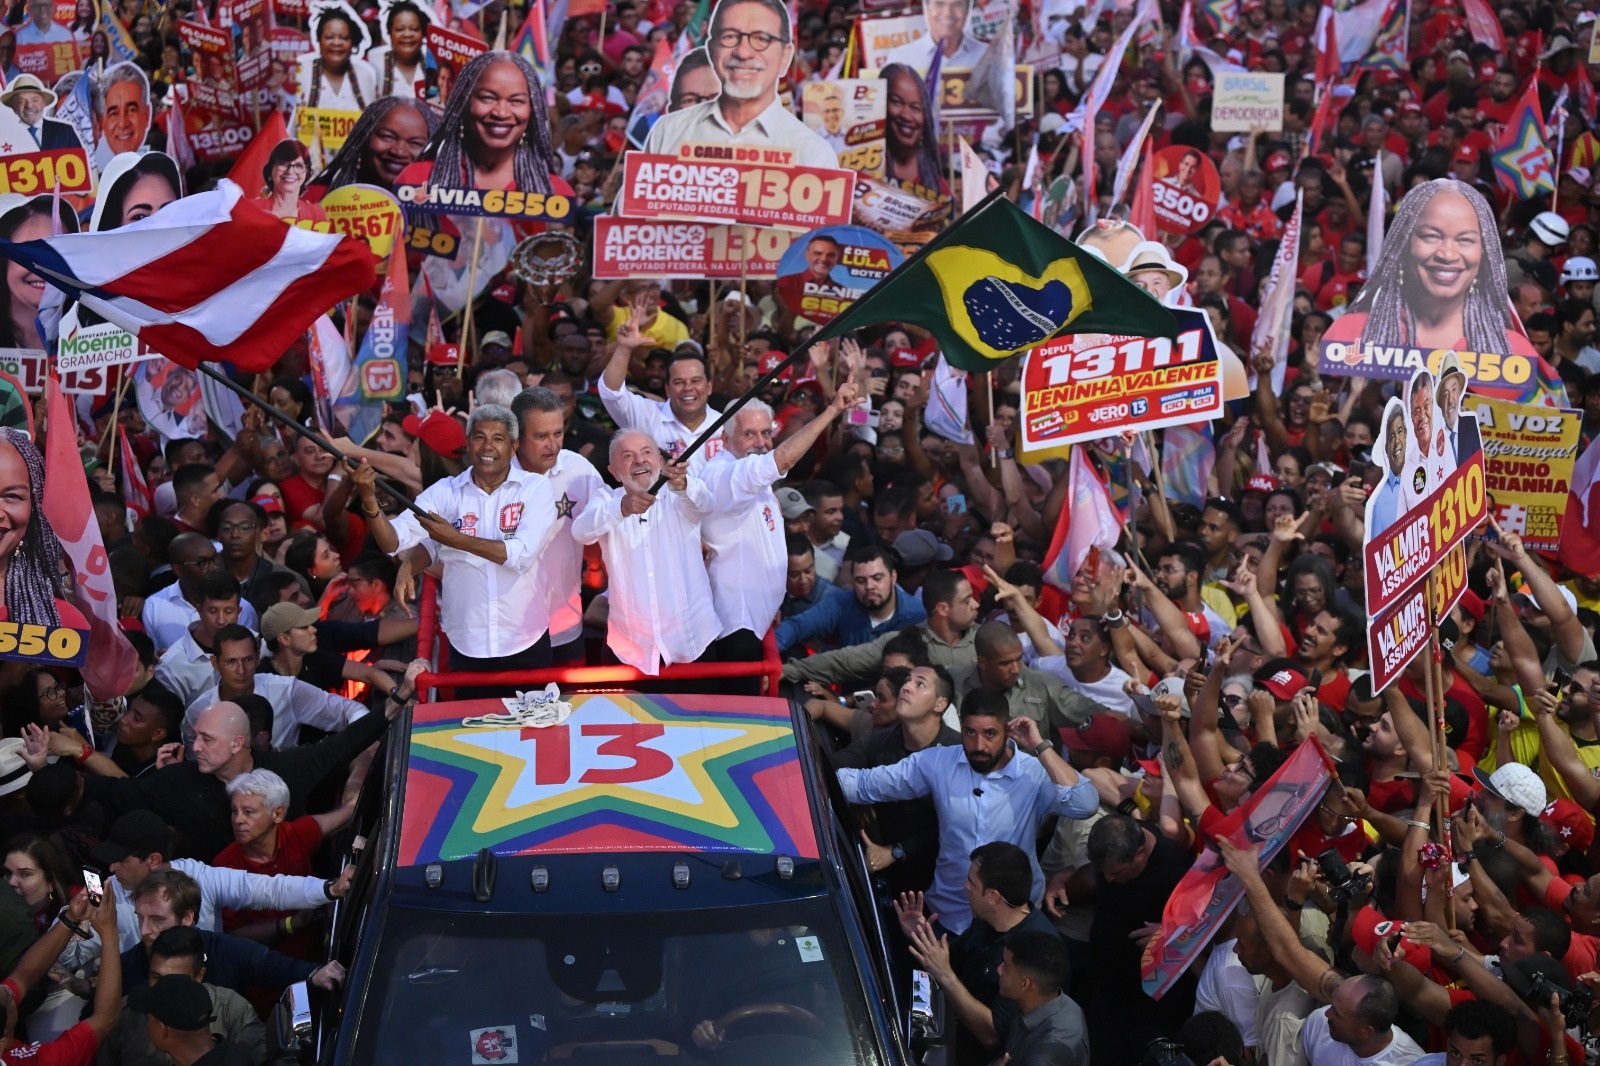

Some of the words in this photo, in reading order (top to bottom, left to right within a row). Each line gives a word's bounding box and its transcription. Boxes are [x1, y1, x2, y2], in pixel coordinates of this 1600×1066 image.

[430, 33, 445, 46] OS
[438, 46, 453, 60] DO
[1223, 76, 1270, 92] BRASIL
[1214, 106, 1279, 122] DEMOCRACIA
[681, 144, 691, 158] O
[694, 146, 734, 161] CARA
[736, 147, 759, 162] DO
[764, 150, 793, 165] VLT
[0, 153, 86, 194] 1310
[635, 162, 740, 188] AFONSO
[633, 183, 739, 206] FLORENCE
[740, 168, 847, 217] 1301
[325, 203, 358, 213] FÁTIMA
[360, 199, 390, 211] NUNES
[483, 189, 570, 219] 6550
[647, 201, 697, 213] DEPUTADO
[698, 204, 740, 216] FEDERAL
[742, 208, 756, 217] NA
[757, 209, 781, 220] LUTA
[782, 212, 795, 221] DA
[796, 214, 827, 225] GENTE
[604, 223, 707, 245] AFONSO
[706, 226, 801, 262] 130
[604, 244, 705, 261] FLORENCE
[842, 254, 889, 269] LULA
[854, 247, 871, 257] DE
[618, 261, 666, 271] DEPUTADO
[667, 262, 709, 271] FEDERAL
[711, 263, 724, 271] NA
[850, 268, 882, 278] BOTE
[993, 278, 1023, 308] ORDEM
[60, 333, 133, 358] Moema
[78, 331, 108, 340] DEPUTADA
[60, 347, 133, 369] GRAMACHO
[1042, 329, 1204, 387] 13111
[368, 363, 395, 391] 13
[1026, 377, 1124, 414] LENINHA
[1124, 361, 1219, 394] VALENTE
[1160, 390, 1189, 403] WAGNER
[1193, 386, 1212, 397] RUI
[1066, 411, 1076, 421] 13
[1131, 401, 1147, 416] 13
[1474, 403, 1495, 428] A
[1506, 412, 1563, 434] VOZ
[1031, 416, 1064, 433] LULA
[1495, 431, 1518, 440] está
[1520, 434, 1561, 443] fazendo
[503, 506, 521, 528] 13
[1429, 463, 1483, 553] 1310
[1526, 514, 1558, 523] LUTA
[1527, 505, 1557, 516] ESSA
[1525, 529, 1560, 538] PARA
[1526, 521, 1559, 531] NUNCA
[1373, 514, 1431, 582] VALMIR
[1381, 545, 1431, 600] ASSUNÇÃO
[1376, 592, 1426, 660] VALMIR
[1384, 620, 1427, 677] ASSUNÇÃO
[519, 723, 675, 787] 13
